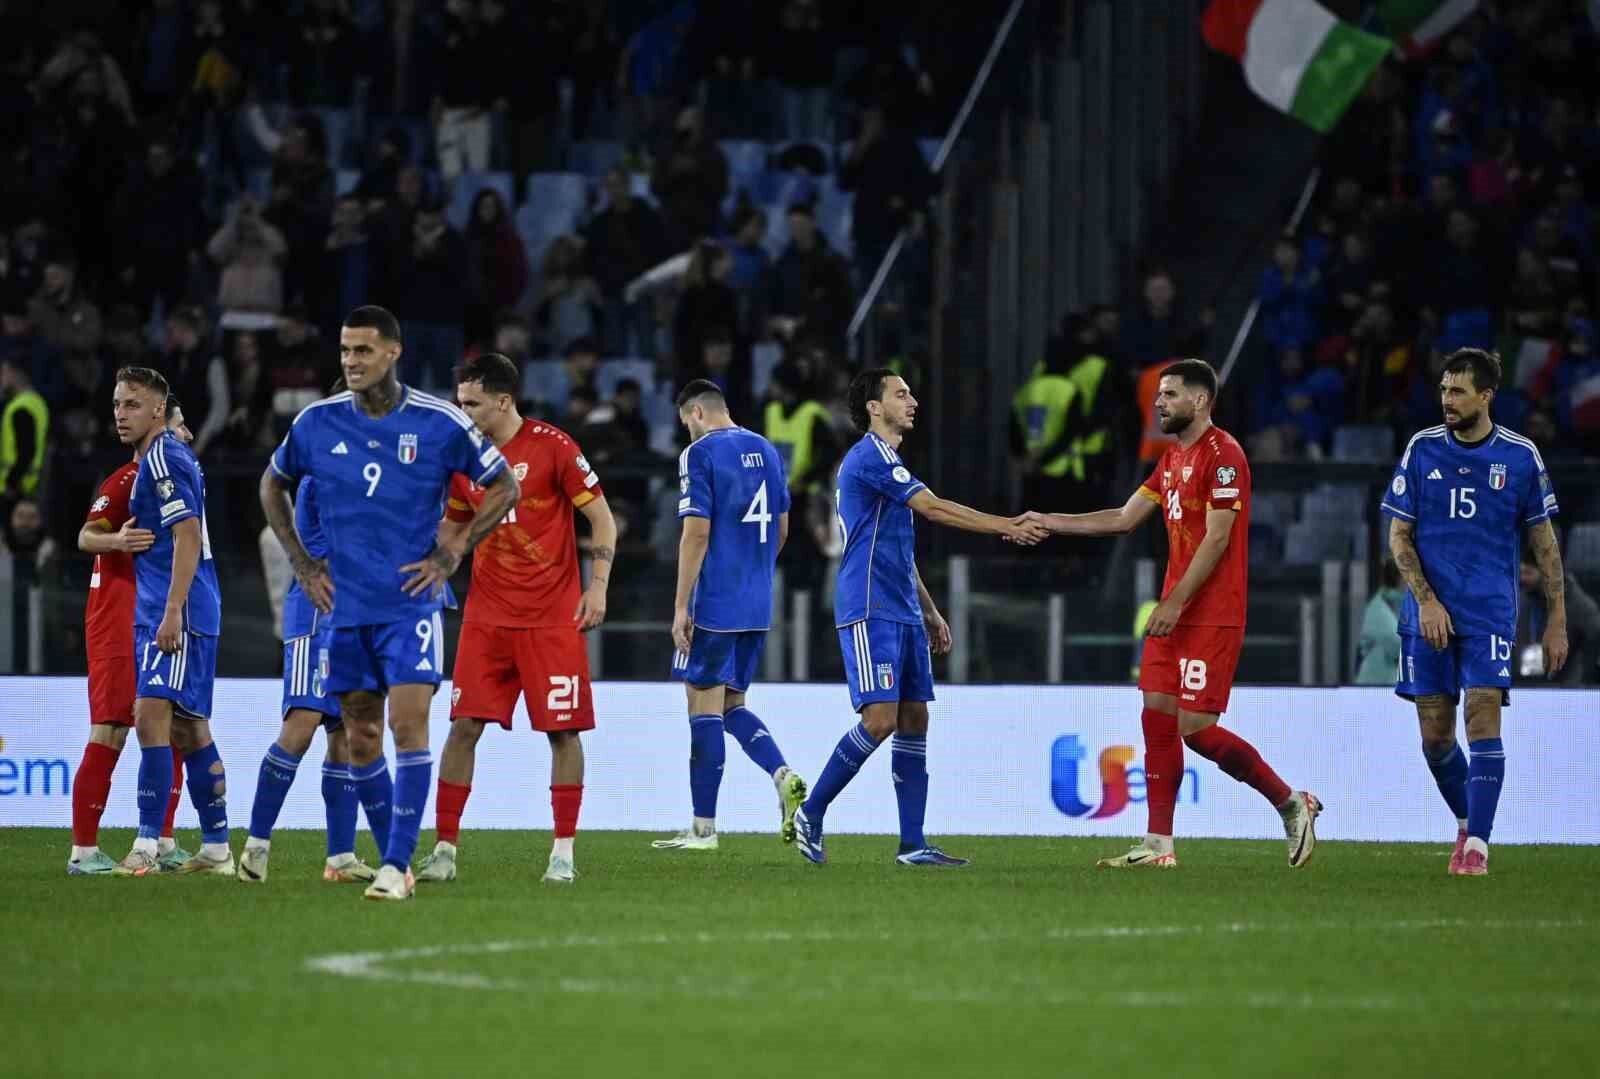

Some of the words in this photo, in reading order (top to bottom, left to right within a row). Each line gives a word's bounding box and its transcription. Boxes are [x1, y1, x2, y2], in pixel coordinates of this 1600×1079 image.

[741, 452, 764, 468] GATTI
[363, 462, 382, 497] 9
[742, 480, 772, 544] 4
[1449, 488, 1477, 518] 15
[416, 619, 433, 653] 9
[1179, 658, 1207, 690] 18
[547, 675, 579, 710] 21
